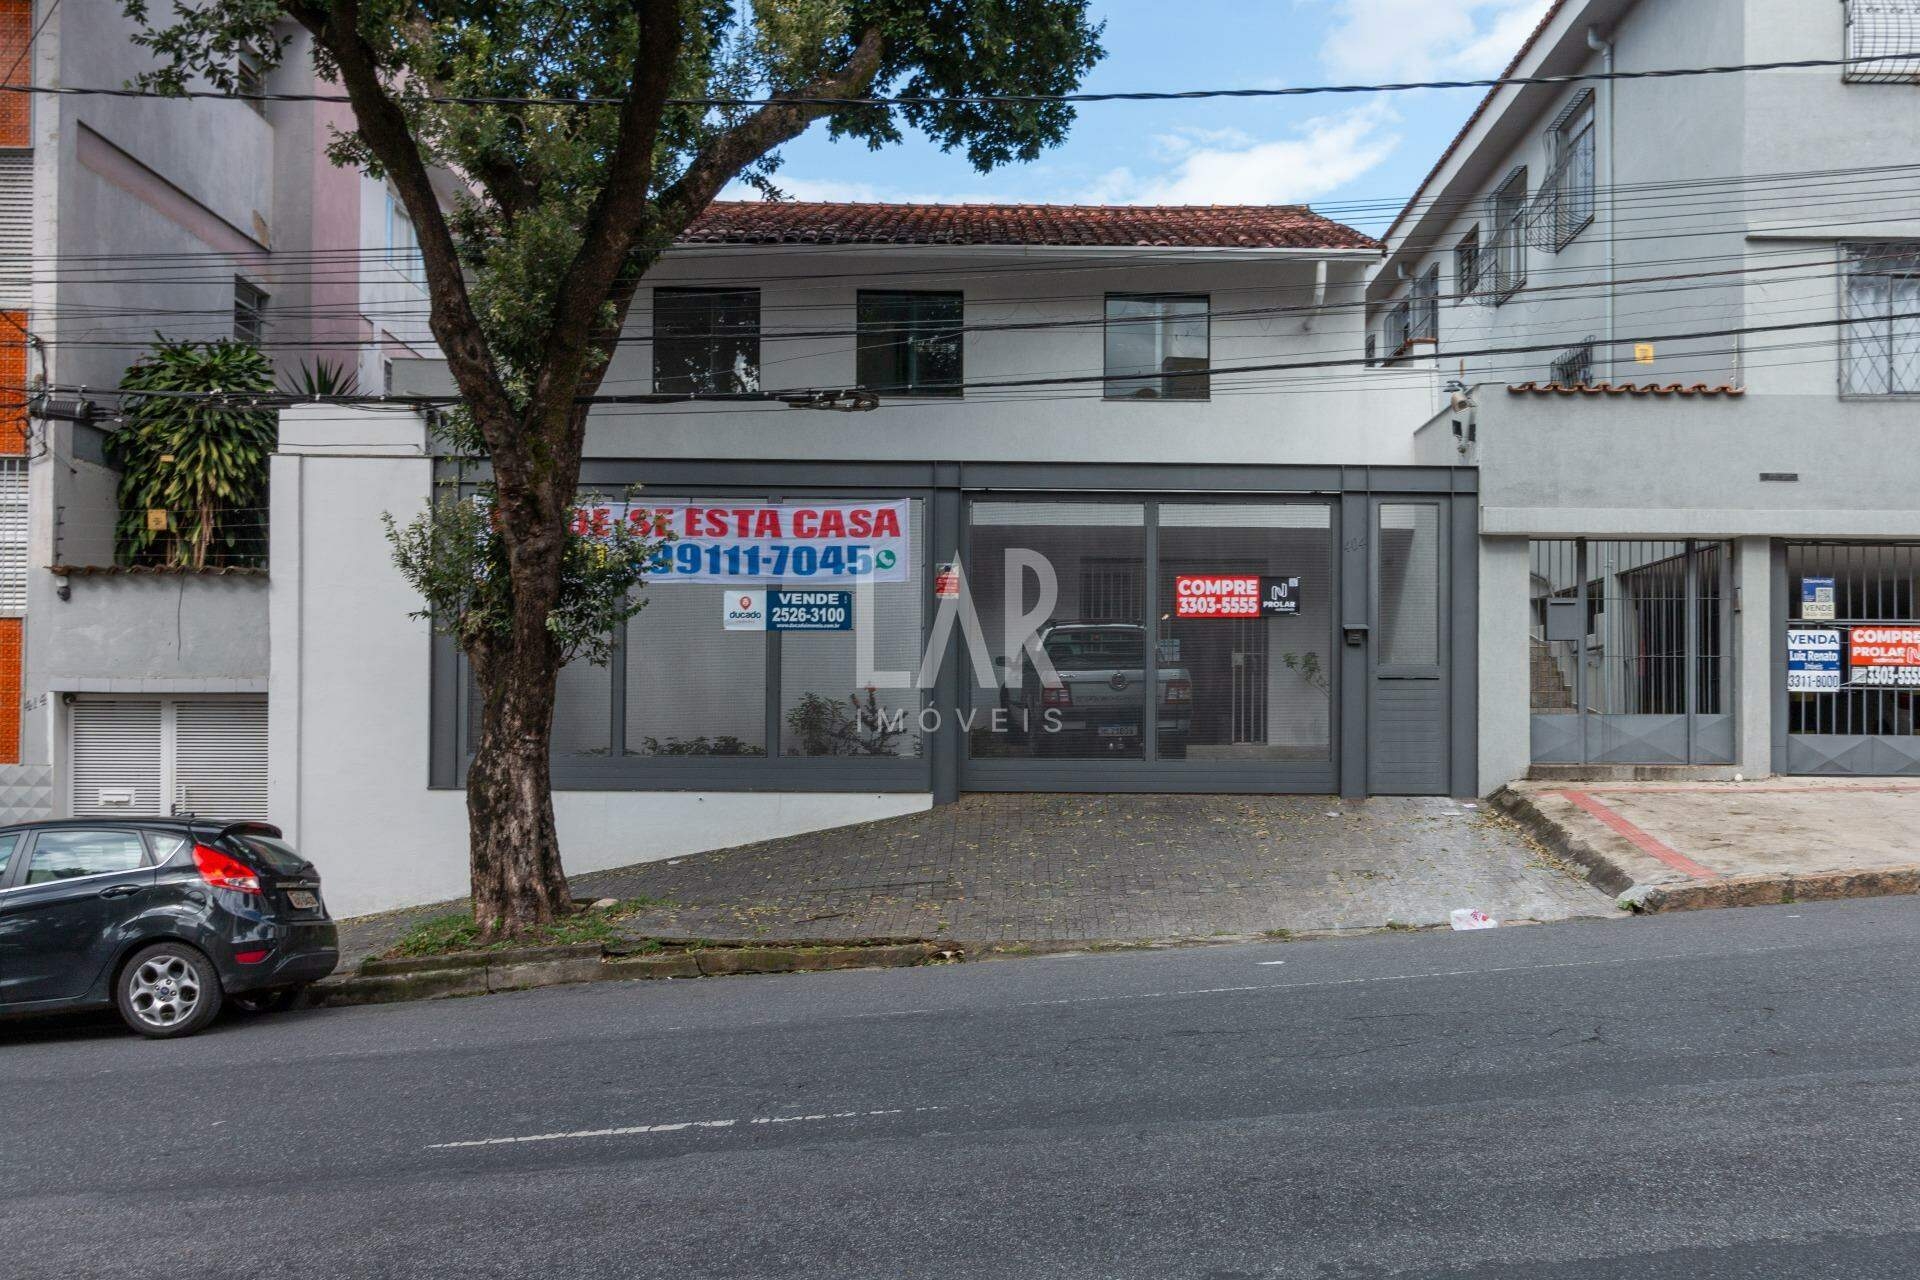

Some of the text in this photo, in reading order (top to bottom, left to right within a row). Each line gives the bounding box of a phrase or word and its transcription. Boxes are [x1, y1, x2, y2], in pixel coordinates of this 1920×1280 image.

[685, 508, 782, 538] ESTA
[793, 509, 900, 538] CASA
[649, 543, 872, 576] 99111-7045
[1178, 580, 1258, 595] COMPRE
[779, 593, 839, 604] VENDE
[1179, 597, 1258, 613] 3303-5555
[729, 611, 762, 619] ducado
[772, 607, 845, 622] 2526-3100
[1787, 635, 1838, 645] VENDA
[1853, 630, 1920, 643] COMPRE
[1808, 651, 1839, 661] Renato
[1853, 647, 1905, 657] PROLAR
